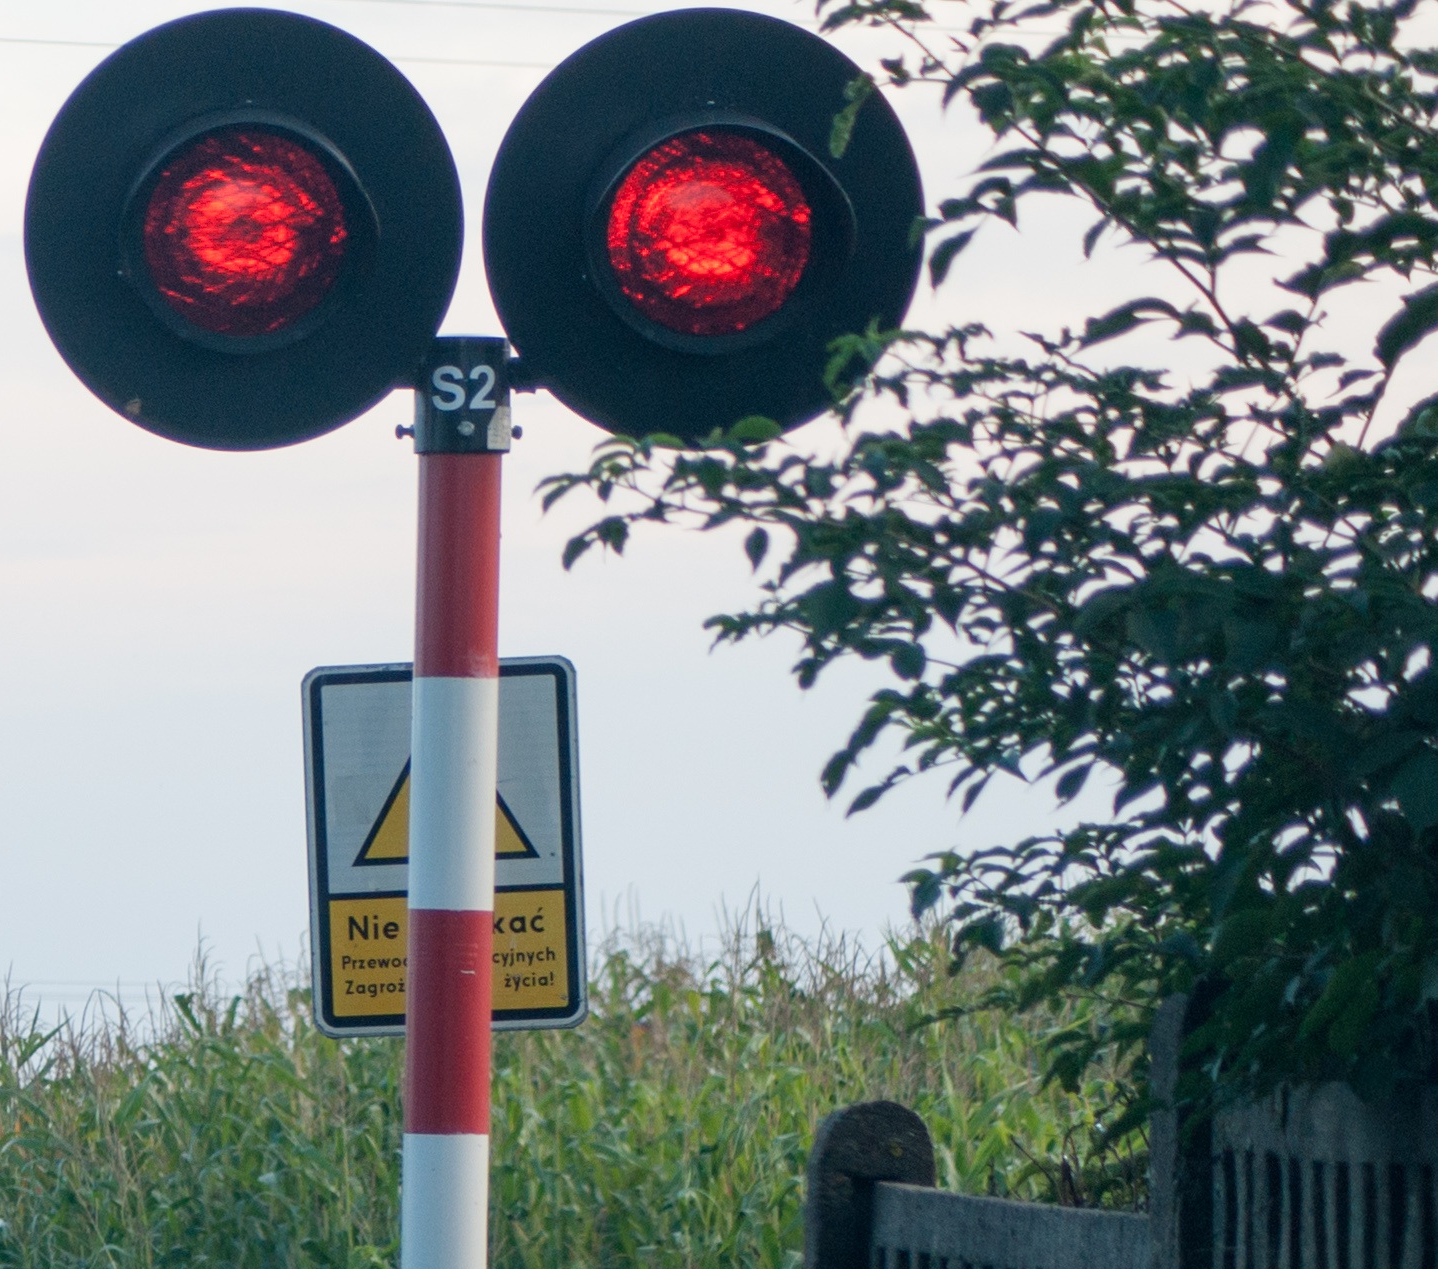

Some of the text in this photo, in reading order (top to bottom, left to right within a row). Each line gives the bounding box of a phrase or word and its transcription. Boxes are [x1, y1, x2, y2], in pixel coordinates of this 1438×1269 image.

[432, 365, 496, 411] S2
[348, 915, 399, 940] Nie
[342, 946, 555, 970] Przewo cyjnych
[345, 971, 554, 997] Zagroż życia!
